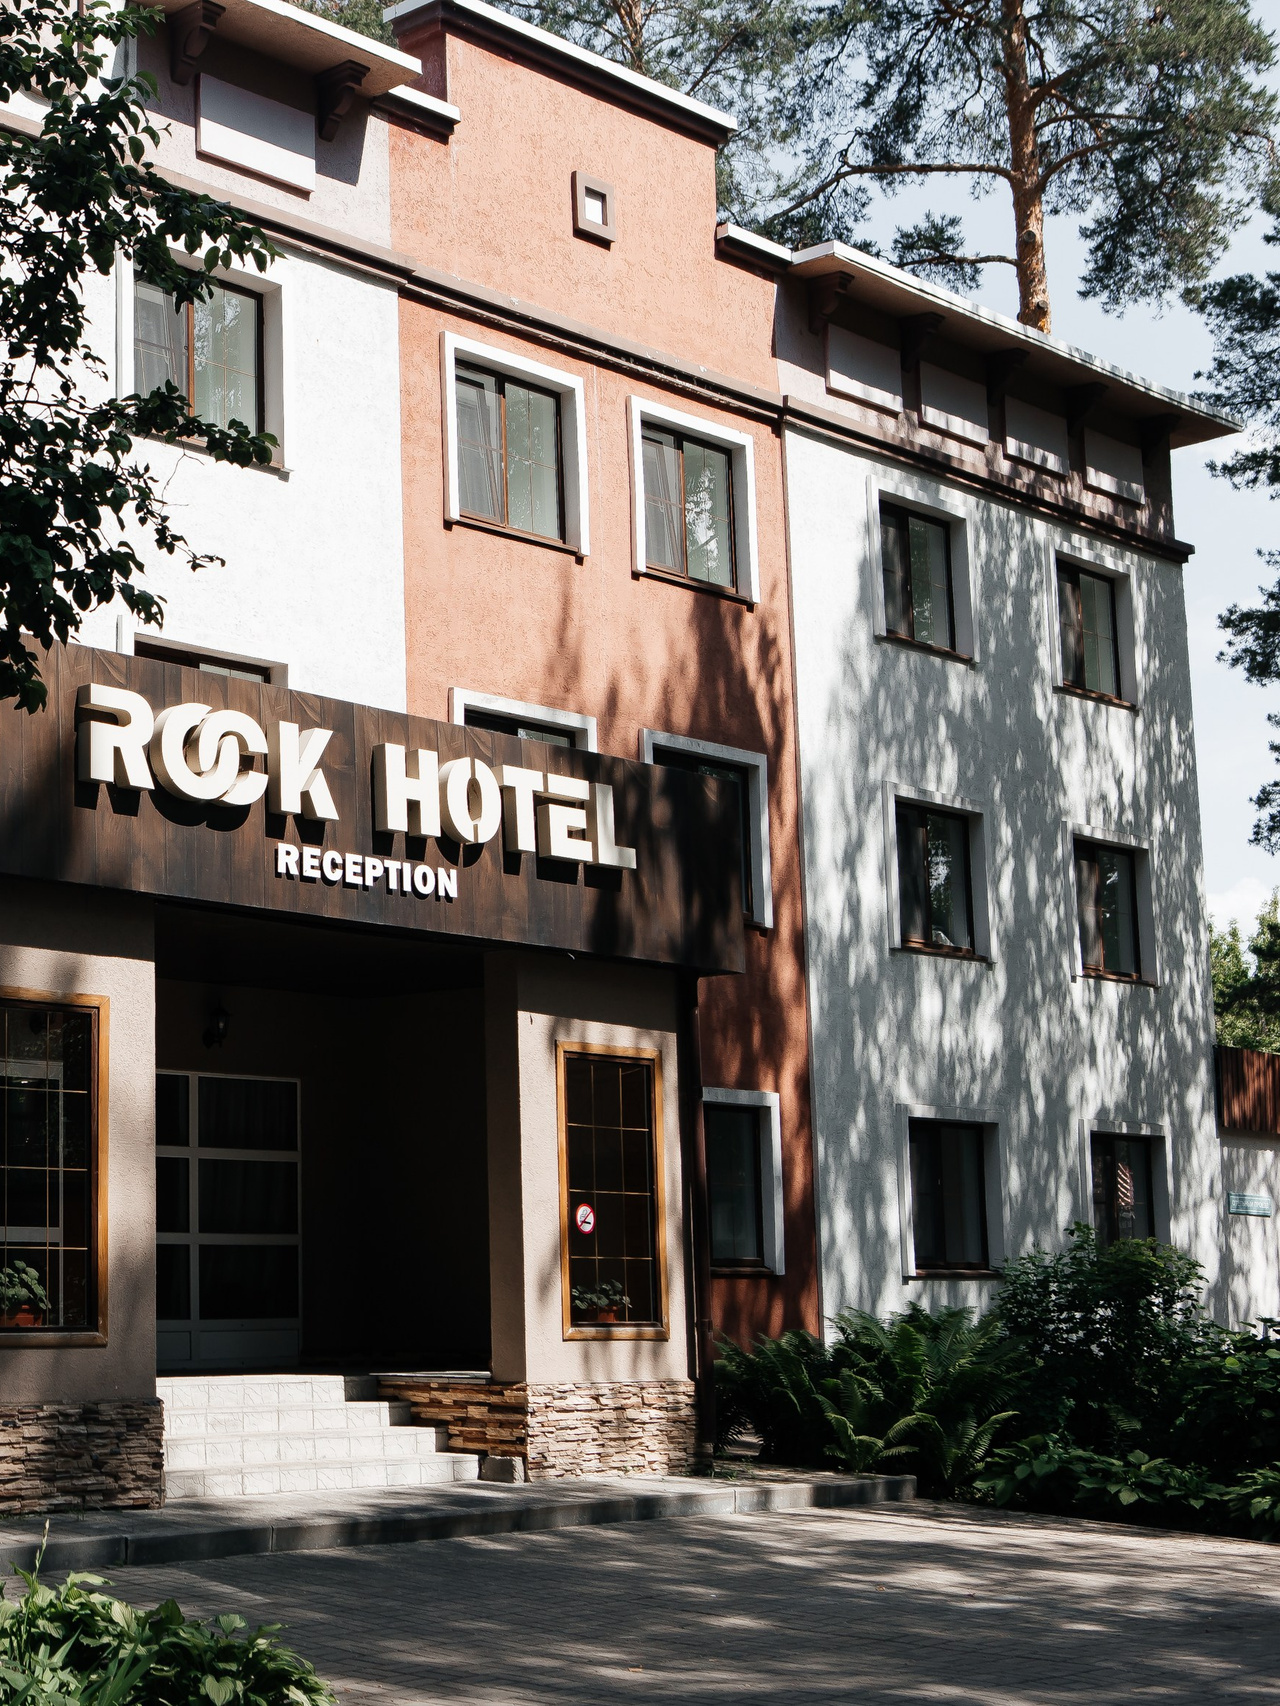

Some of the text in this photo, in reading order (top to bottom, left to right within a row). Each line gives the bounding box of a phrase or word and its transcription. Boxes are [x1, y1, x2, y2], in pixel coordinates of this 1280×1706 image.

[78, 683, 637, 869] ROCK HOTEL
[277, 842, 458, 898] RECEPTION
